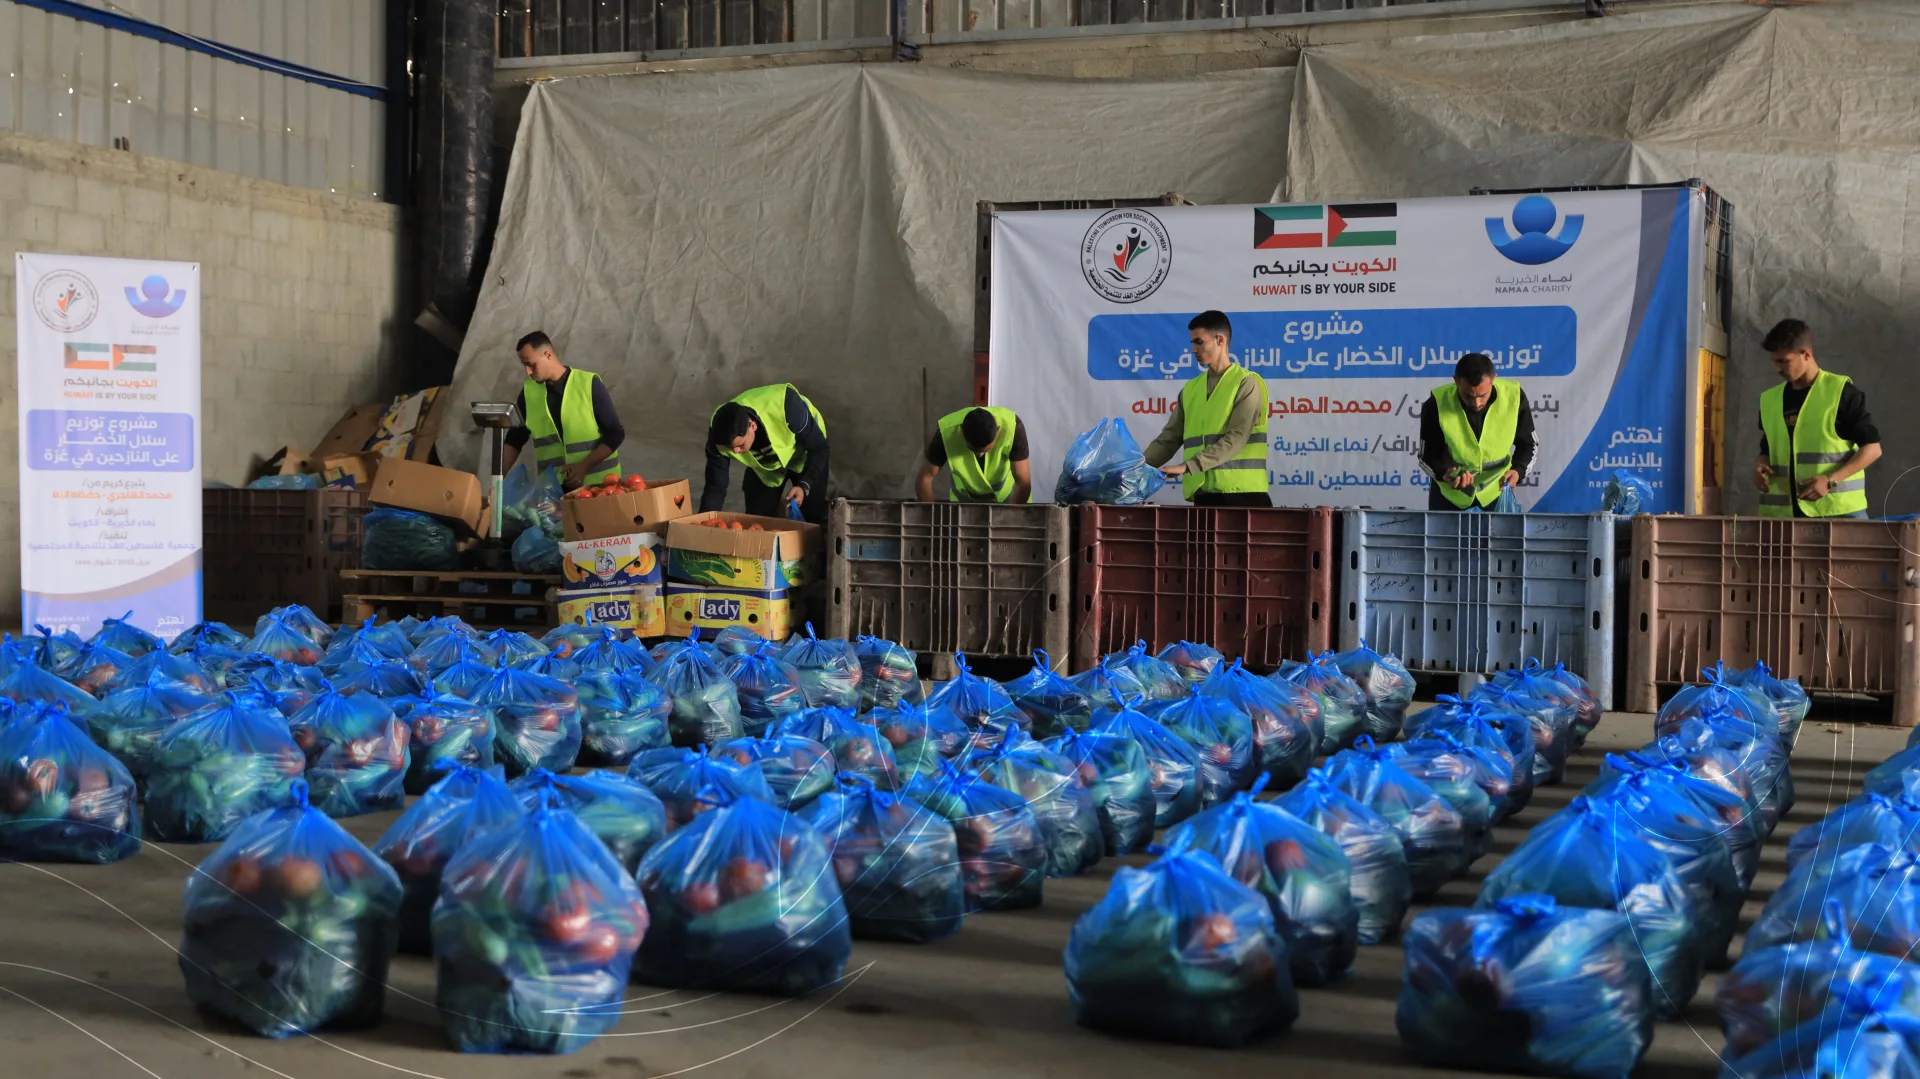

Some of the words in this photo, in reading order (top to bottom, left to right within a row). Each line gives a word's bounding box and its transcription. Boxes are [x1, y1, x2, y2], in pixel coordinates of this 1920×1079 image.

[1086, 229, 1100, 253] PALESTINE
[1098, 213, 1122, 230] TOMORROW
[1133, 213, 1148, 224] SOCIAL
[1148, 220, 1168, 252] DEVELOPMENT
[1252, 260, 1328, 278] بجانبكم
[1332, 257, 1397, 276] الكويت
[1252, 284, 1297, 296] KUWAIT
[1300, 284, 1312, 294] IS
[1315, 284, 1330, 294] BY
[1333, 282, 1365, 294] YOUR
[1368, 282, 1396, 293] SIDE
[1495, 286, 1529, 294] NAMAA
[1532, 285, 1572, 293] CHARITY
[1283, 311, 1364, 344] مشروع
[1118, 348, 1153, 372] غزة
[1159, 348, 1192, 380] في
[1286, 348, 1329, 373] على
[1334, 346, 1402, 371] الخضار
[64, 376, 114, 388] بجانبكم
[116, 378, 157, 388] الكويت
[1131, 398, 1166, 414] الله
[1268, 396, 1328, 419] الهاجر
[1331, 398, 1392, 414] محمد
[66, 416, 105, 432] توزيع
[108, 414, 158, 432] مشروع
[129, 434, 166, 448] سلال
[1334, 438, 1368, 452] نماء
[1608, 426, 1662, 448] نهتم
[1273, 436, 1329, 456] الخيرية
[44, 449, 68, 464] غزة
[72, 451, 94, 468] في
[96, 450, 149, 466] النازحين
[152, 452, 179, 466] على
[1589, 452, 1662, 473] بالإنسان
[1278, 471, 1314, 486] الغد
[1318, 471, 1401, 491] فلسطين
[577, 536, 632, 550] AL-KERAM
[700, 598, 740, 620] Lady
